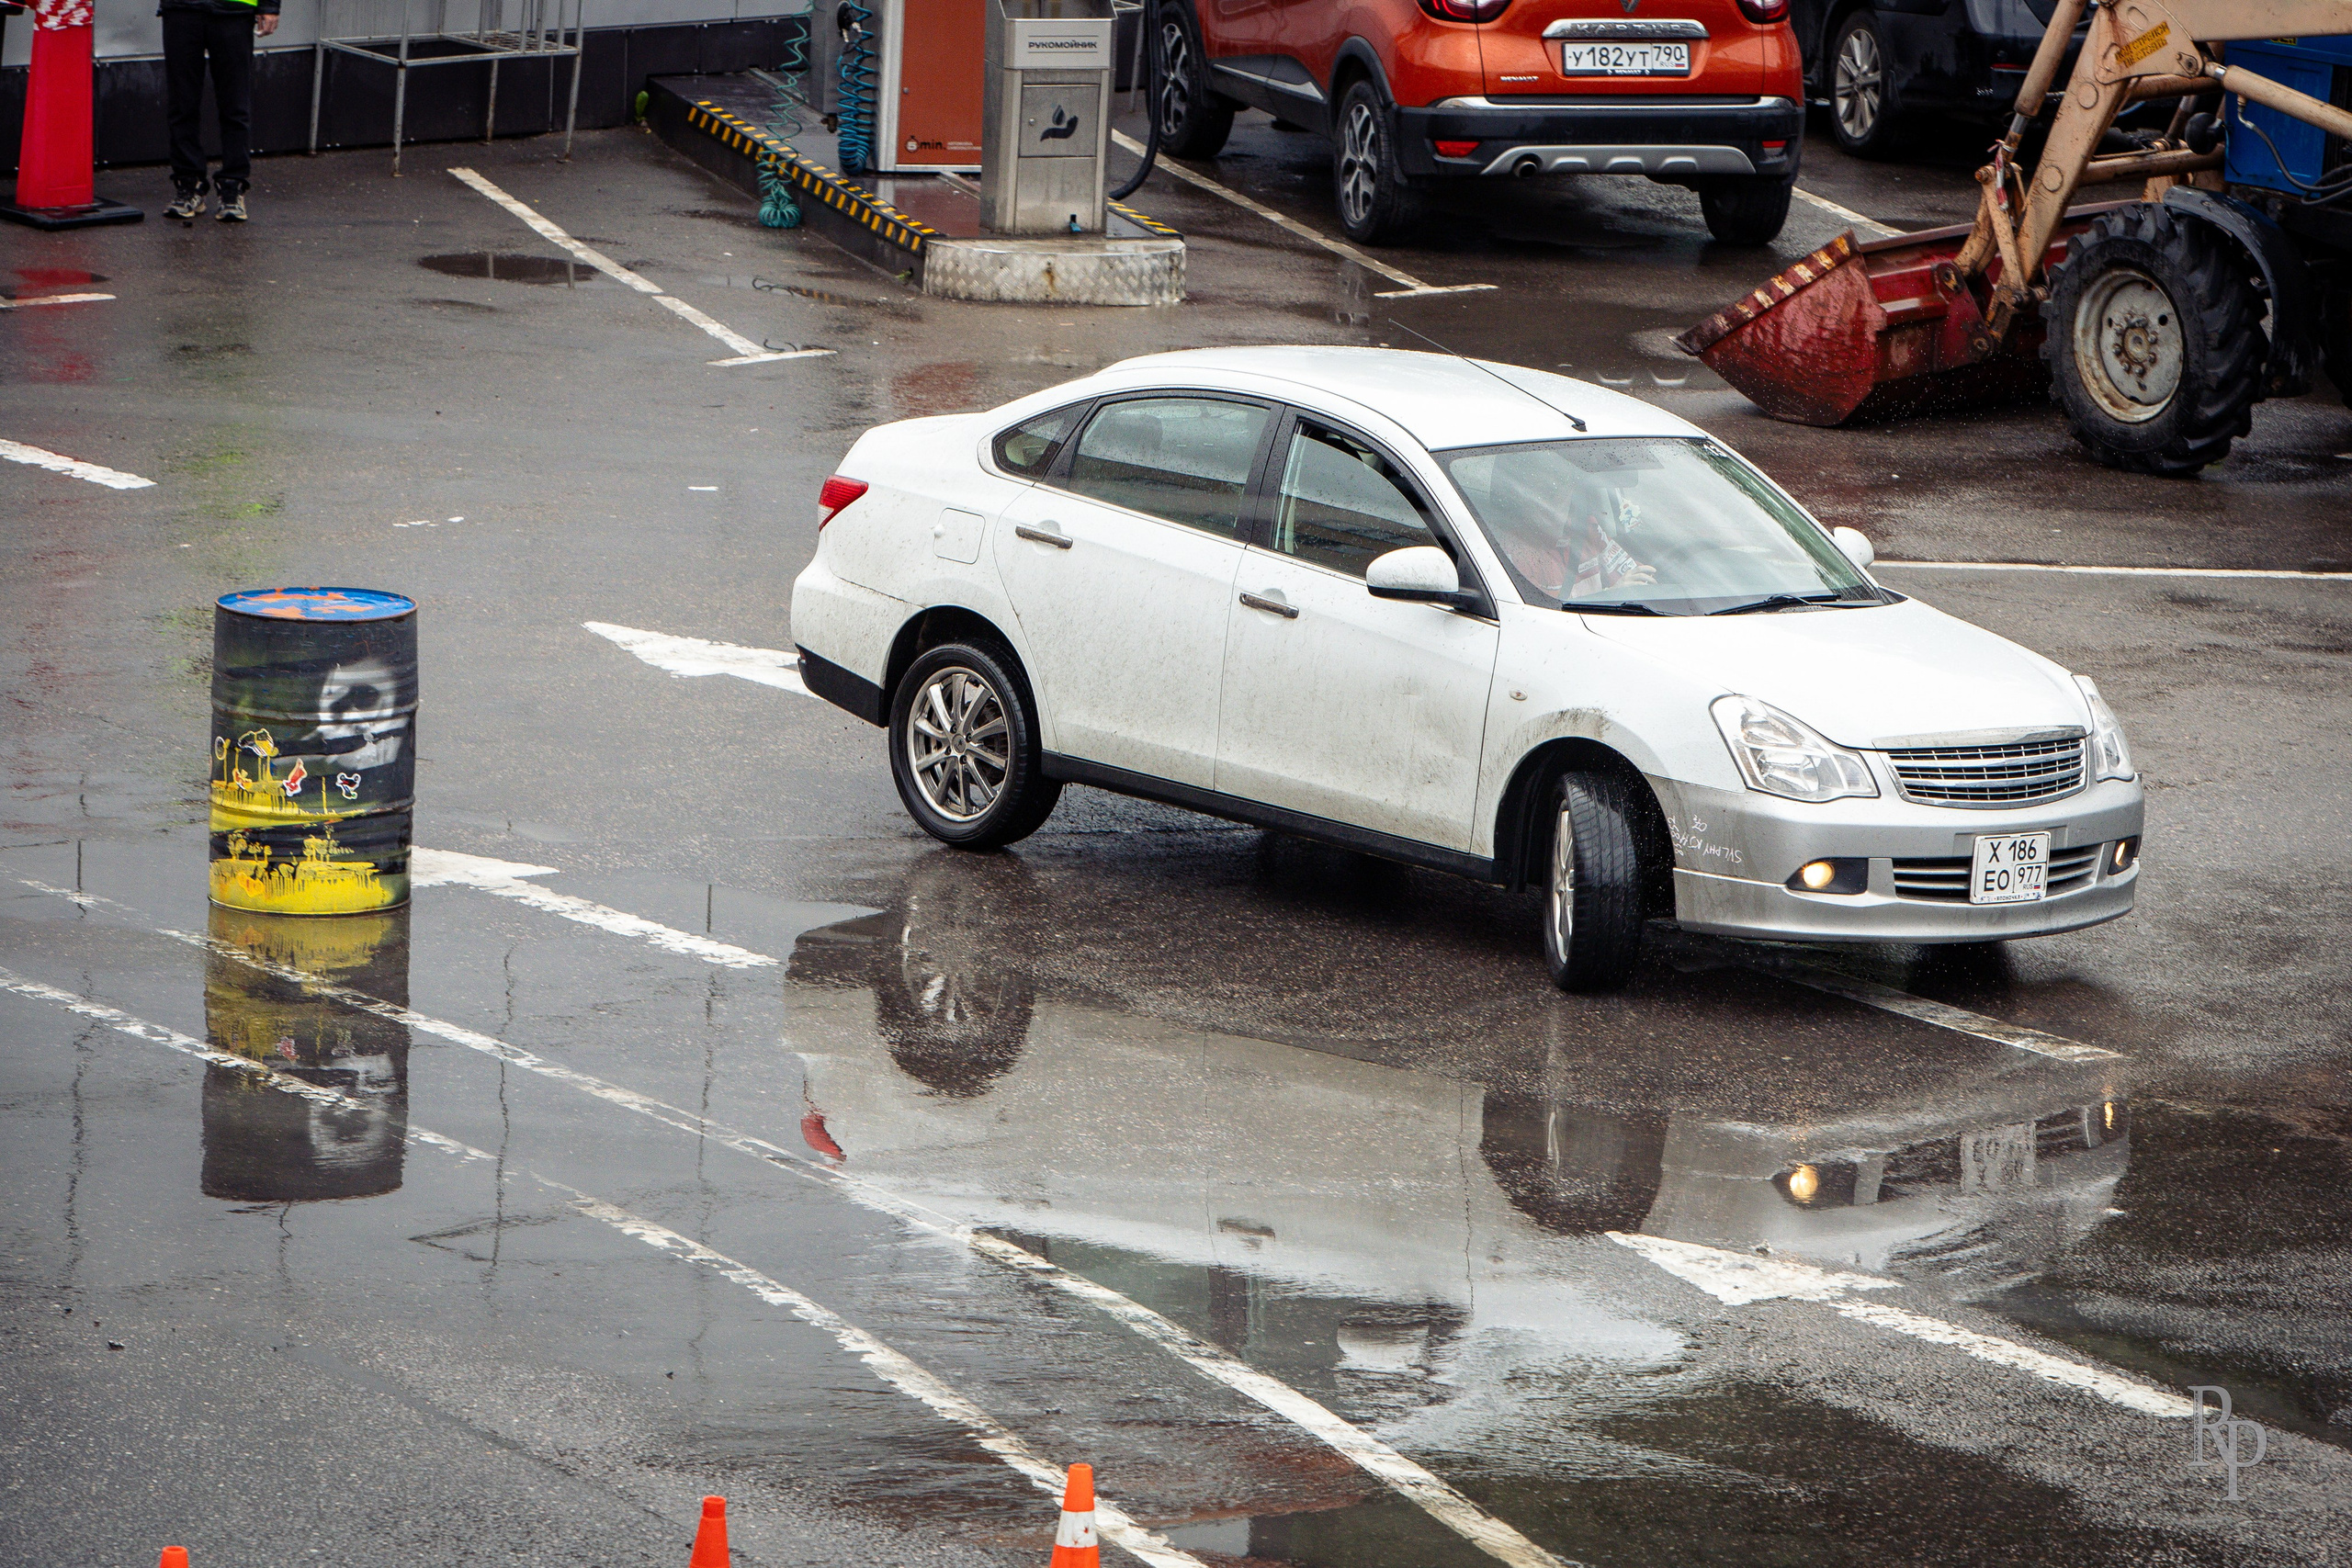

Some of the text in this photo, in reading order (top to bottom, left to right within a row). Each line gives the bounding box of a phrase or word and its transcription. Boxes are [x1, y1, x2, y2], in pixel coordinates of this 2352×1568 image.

[1027, 39, 1098, 49] РУКОМОЙНИК
[1653, 46, 1683, 62] 790
[1702, 843, 1742, 863] SYLPHY
[2008, 839, 2037, 862] 186
[2018, 865, 2041, 884] 977
